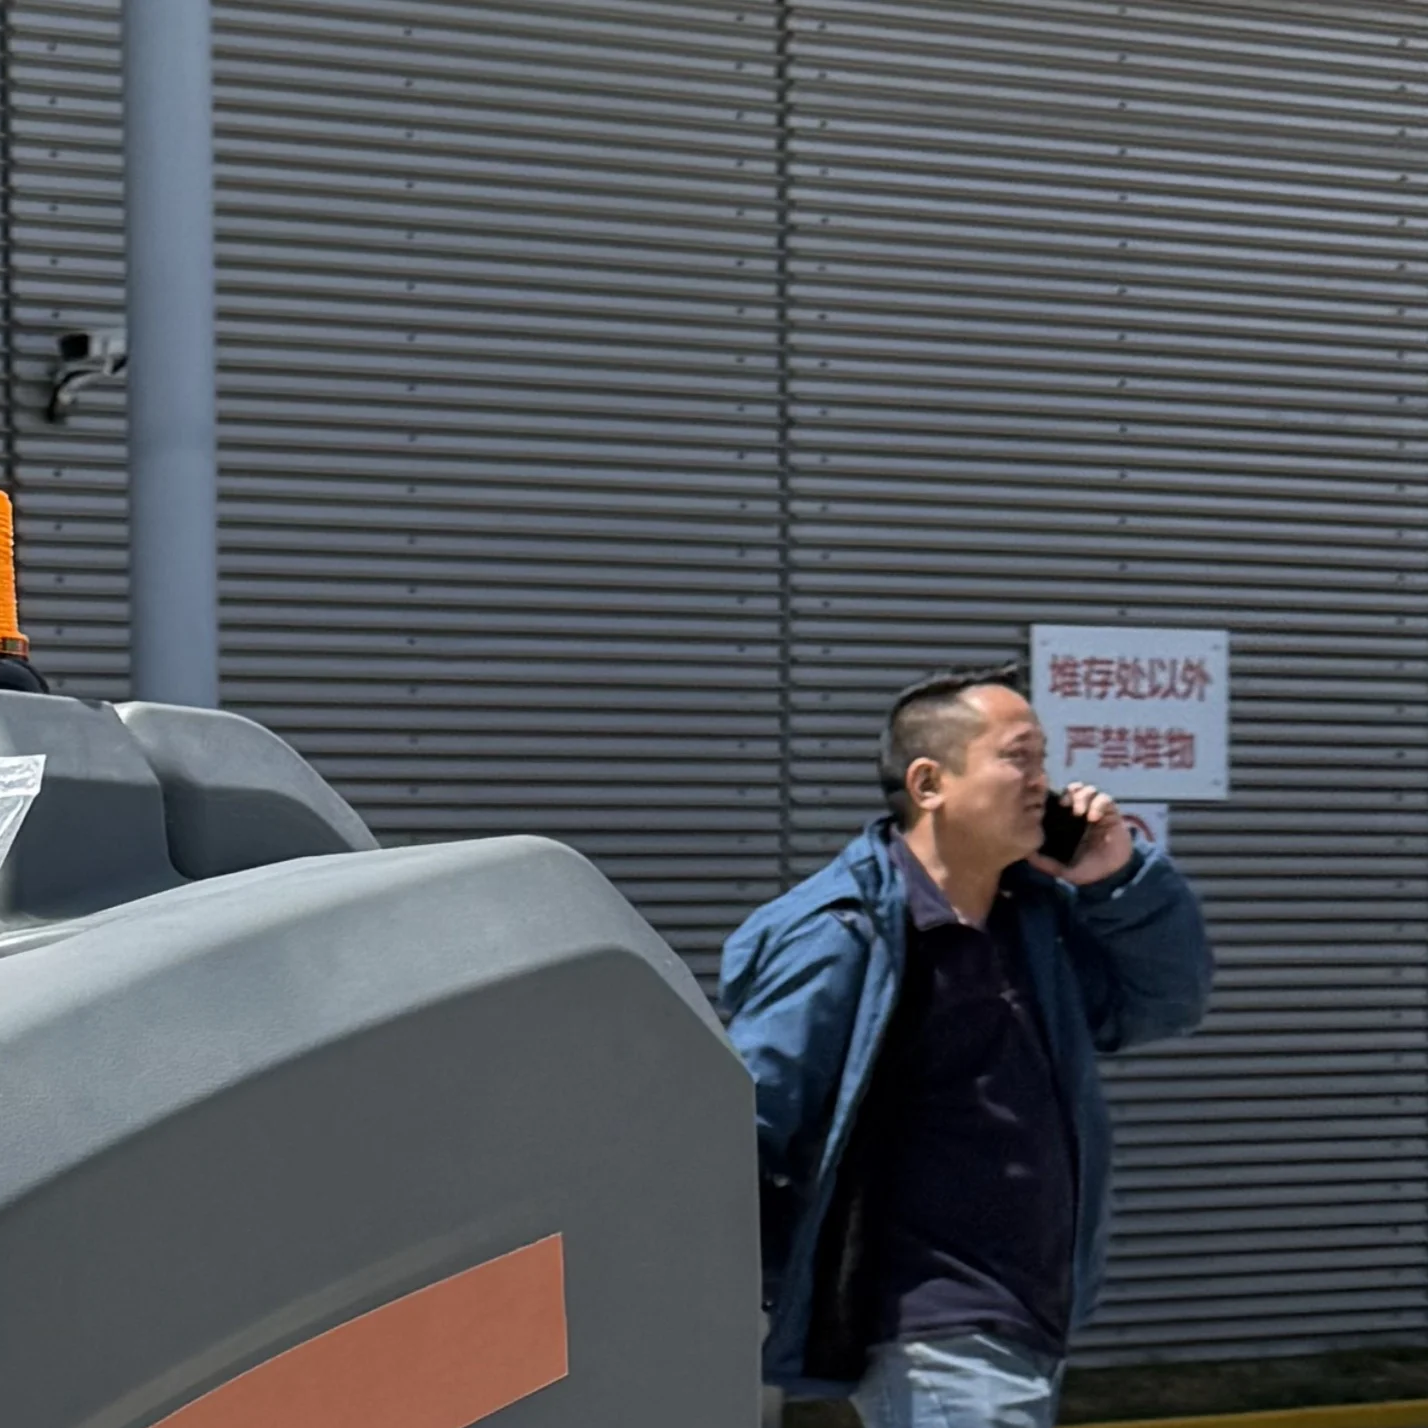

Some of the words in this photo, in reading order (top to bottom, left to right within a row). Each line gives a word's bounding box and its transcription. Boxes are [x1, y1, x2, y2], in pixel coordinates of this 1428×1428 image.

[1048, 654, 1212, 702] 堆存处以外
